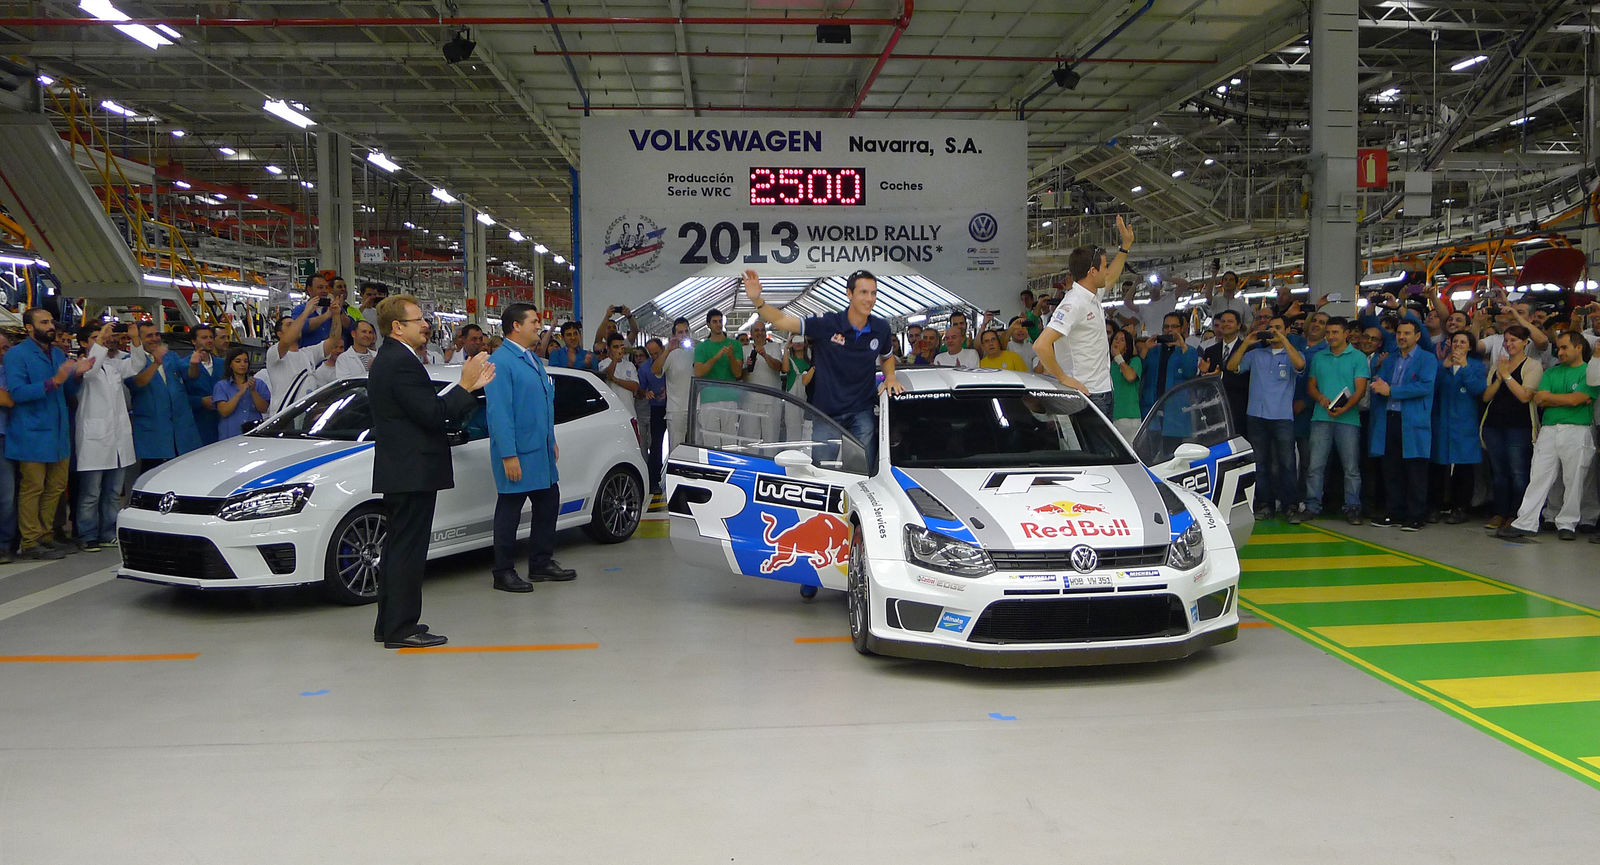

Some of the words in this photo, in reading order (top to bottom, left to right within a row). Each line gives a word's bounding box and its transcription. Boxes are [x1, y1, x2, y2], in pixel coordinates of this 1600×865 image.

[628, 129, 822, 152] VOLKSWAGEN
[849, 136, 934, 156] Navarra,
[945, 136, 983, 154] S.A.
[667, 172, 734, 184] Producción
[750, 168, 860, 204] 2500
[879, 180, 923, 191] Coches
[667, 186, 698, 197] Serie
[700, 186, 732, 197] WRC
[807, 225, 879, 242] WORLD
[884, 224, 942, 241] RALLY
[678, 221, 800, 264] 2013
[894, 392, 951, 400] Volkswagen
[1028, 391, 1081, 399] Volkswagen
[1183, 472, 1208, 491] RC
[759, 480, 825, 505] WRC
[873, 507, 887, 539] Services
[1020, 519, 1078, 539] Red
[1077, 519, 1131, 537] Bull
[433, 526, 468, 541] WRC
[1070, 578, 1084, 586] WOB
[1088, 577, 1097, 585] VW
[1098, 576, 1112, 584] 351
